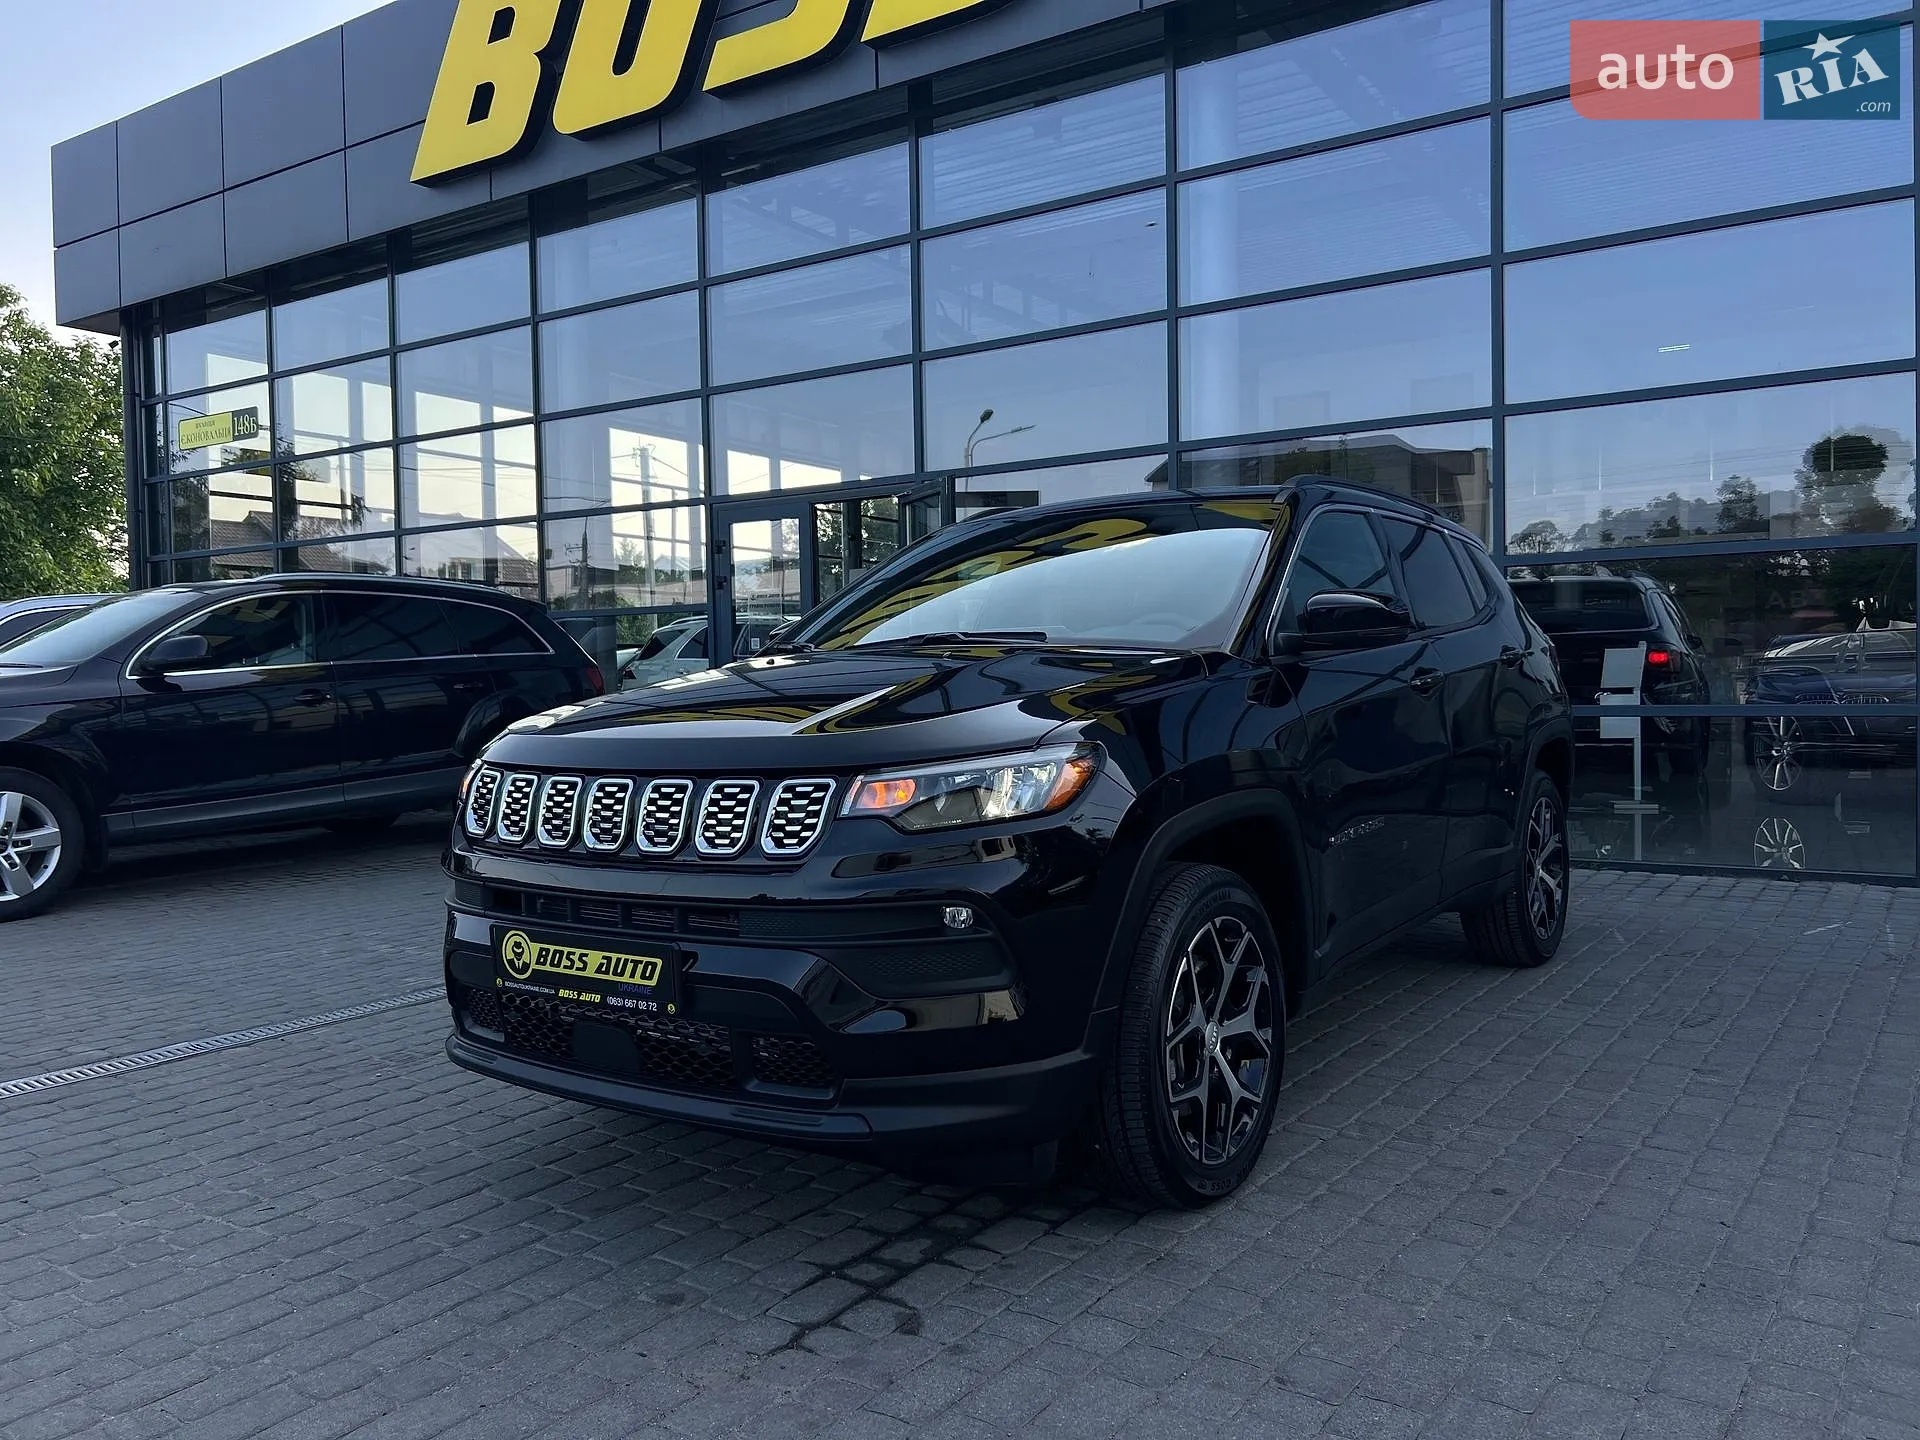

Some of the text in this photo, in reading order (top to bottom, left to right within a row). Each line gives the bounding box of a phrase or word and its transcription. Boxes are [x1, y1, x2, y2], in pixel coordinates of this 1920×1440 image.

[234, 414, 257, 435] 148Б
[535, 947, 659, 981] BOSS AUTO
[558, 989, 601, 1003] BOSS AUTO
[618, 982, 653, 995] UKRAINE
[606, 996, 623, 1006] (063)
[638, 1000, 647, 1010] 02
[647, 1002, 658, 1012] 72
